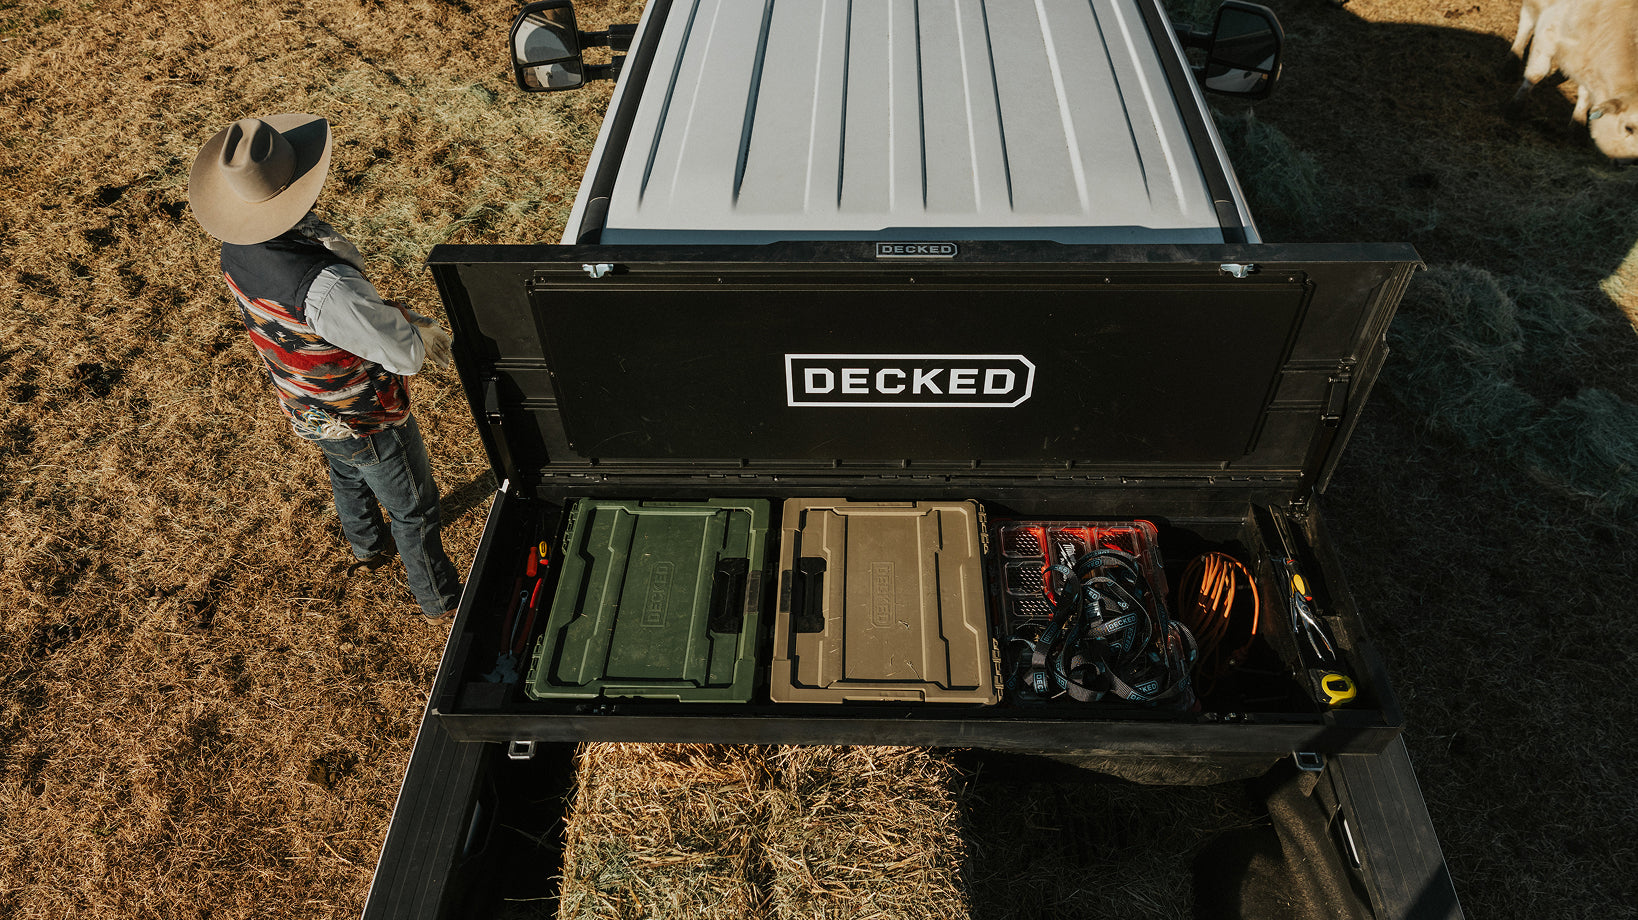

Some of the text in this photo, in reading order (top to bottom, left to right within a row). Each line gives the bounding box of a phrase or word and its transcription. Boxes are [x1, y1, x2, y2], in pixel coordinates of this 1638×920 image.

[881, 245, 952, 254] DECKED
[803, 367, 1016, 395] DECKED
[647, 566, 668, 622] DECKED
[1108, 615, 1136, 629] DECKED
